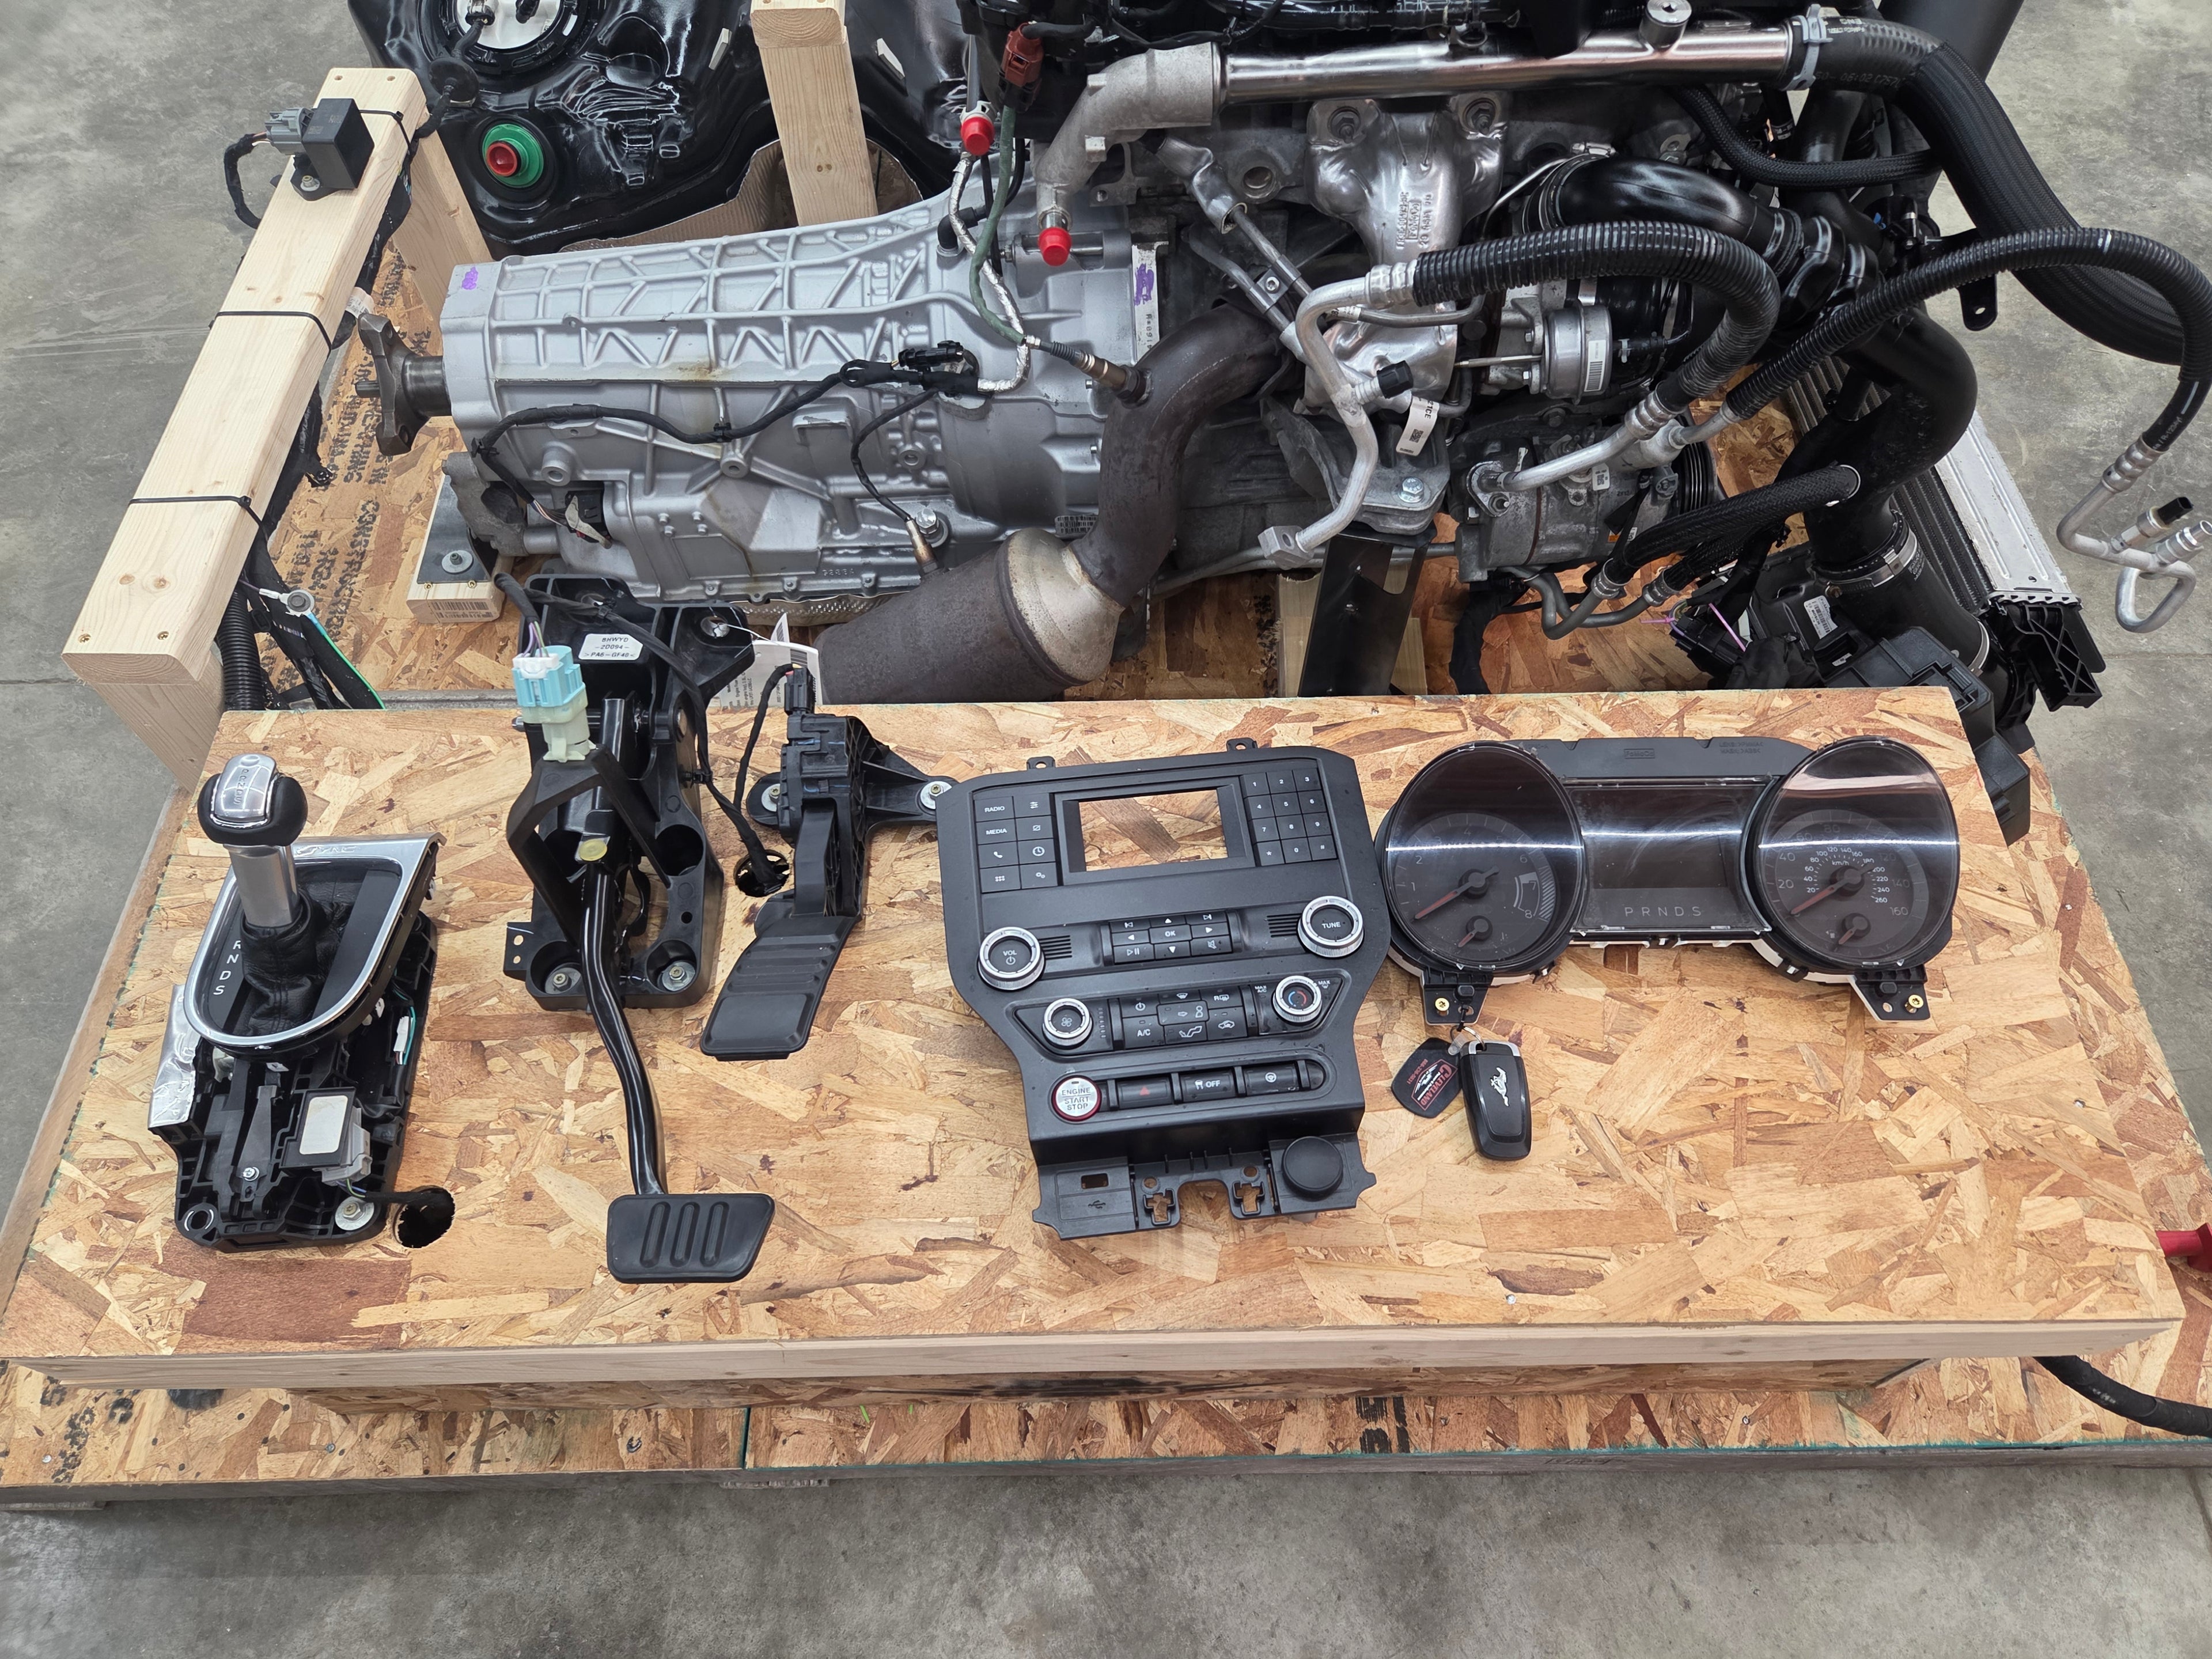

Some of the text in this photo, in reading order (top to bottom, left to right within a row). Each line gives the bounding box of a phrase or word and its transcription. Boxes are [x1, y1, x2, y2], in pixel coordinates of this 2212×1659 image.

[1415, 855, 1423, 864] 2
[1520, 854, 1527, 863] 6
[1779, 852, 1796, 862] 40
[1411, 882, 1416, 891] 1
[1529, 881, 1537, 891] 7
[1778, 879, 1794, 889] 20
[1892, 879, 1910, 889] 140
[1525, 909, 1533, 919] 8
[1890, 906, 1908, 916] 160
[1137, 1028, 1151, 1037] A/C
[1421, 1064, 1452, 1106] CLEVELAND
[1062, 1087, 1091, 1096] ENGINE
[1065, 1096, 1089, 1104] START
